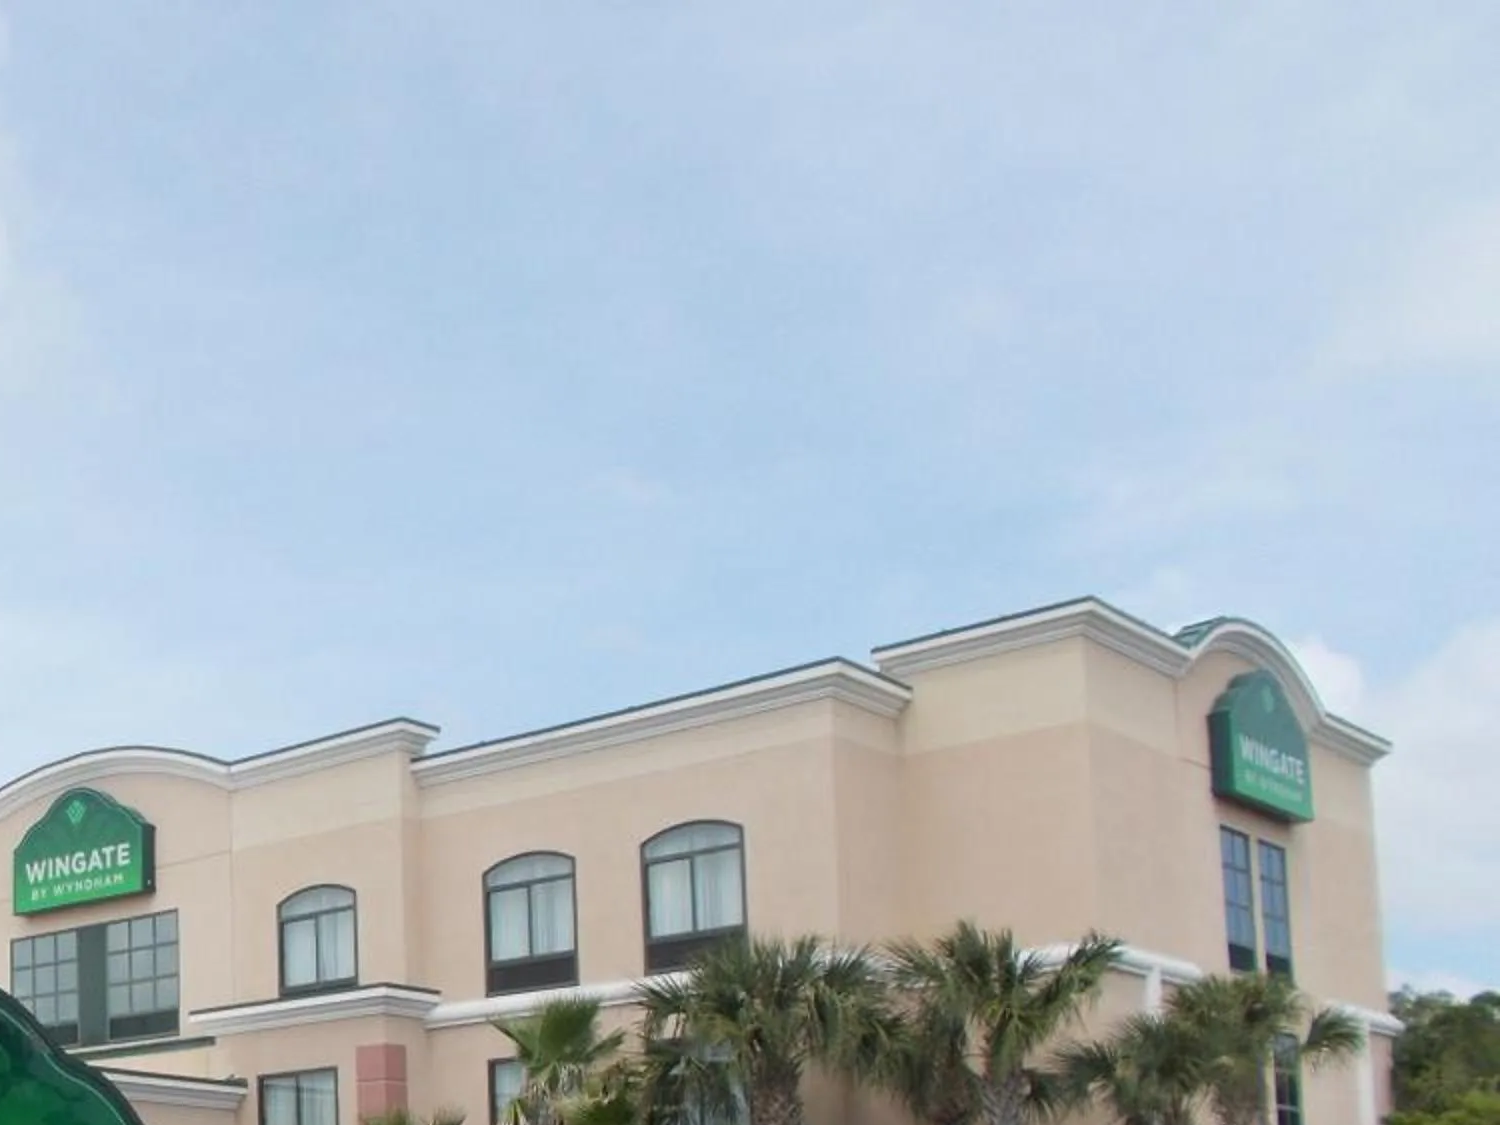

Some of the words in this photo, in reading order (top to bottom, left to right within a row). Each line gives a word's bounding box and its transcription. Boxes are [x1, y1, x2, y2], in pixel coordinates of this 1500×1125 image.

[26, 843, 131, 884] WINGATE
[31, 887, 47, 901] BY
[53, 873, 124, 896] WYNDHAM
